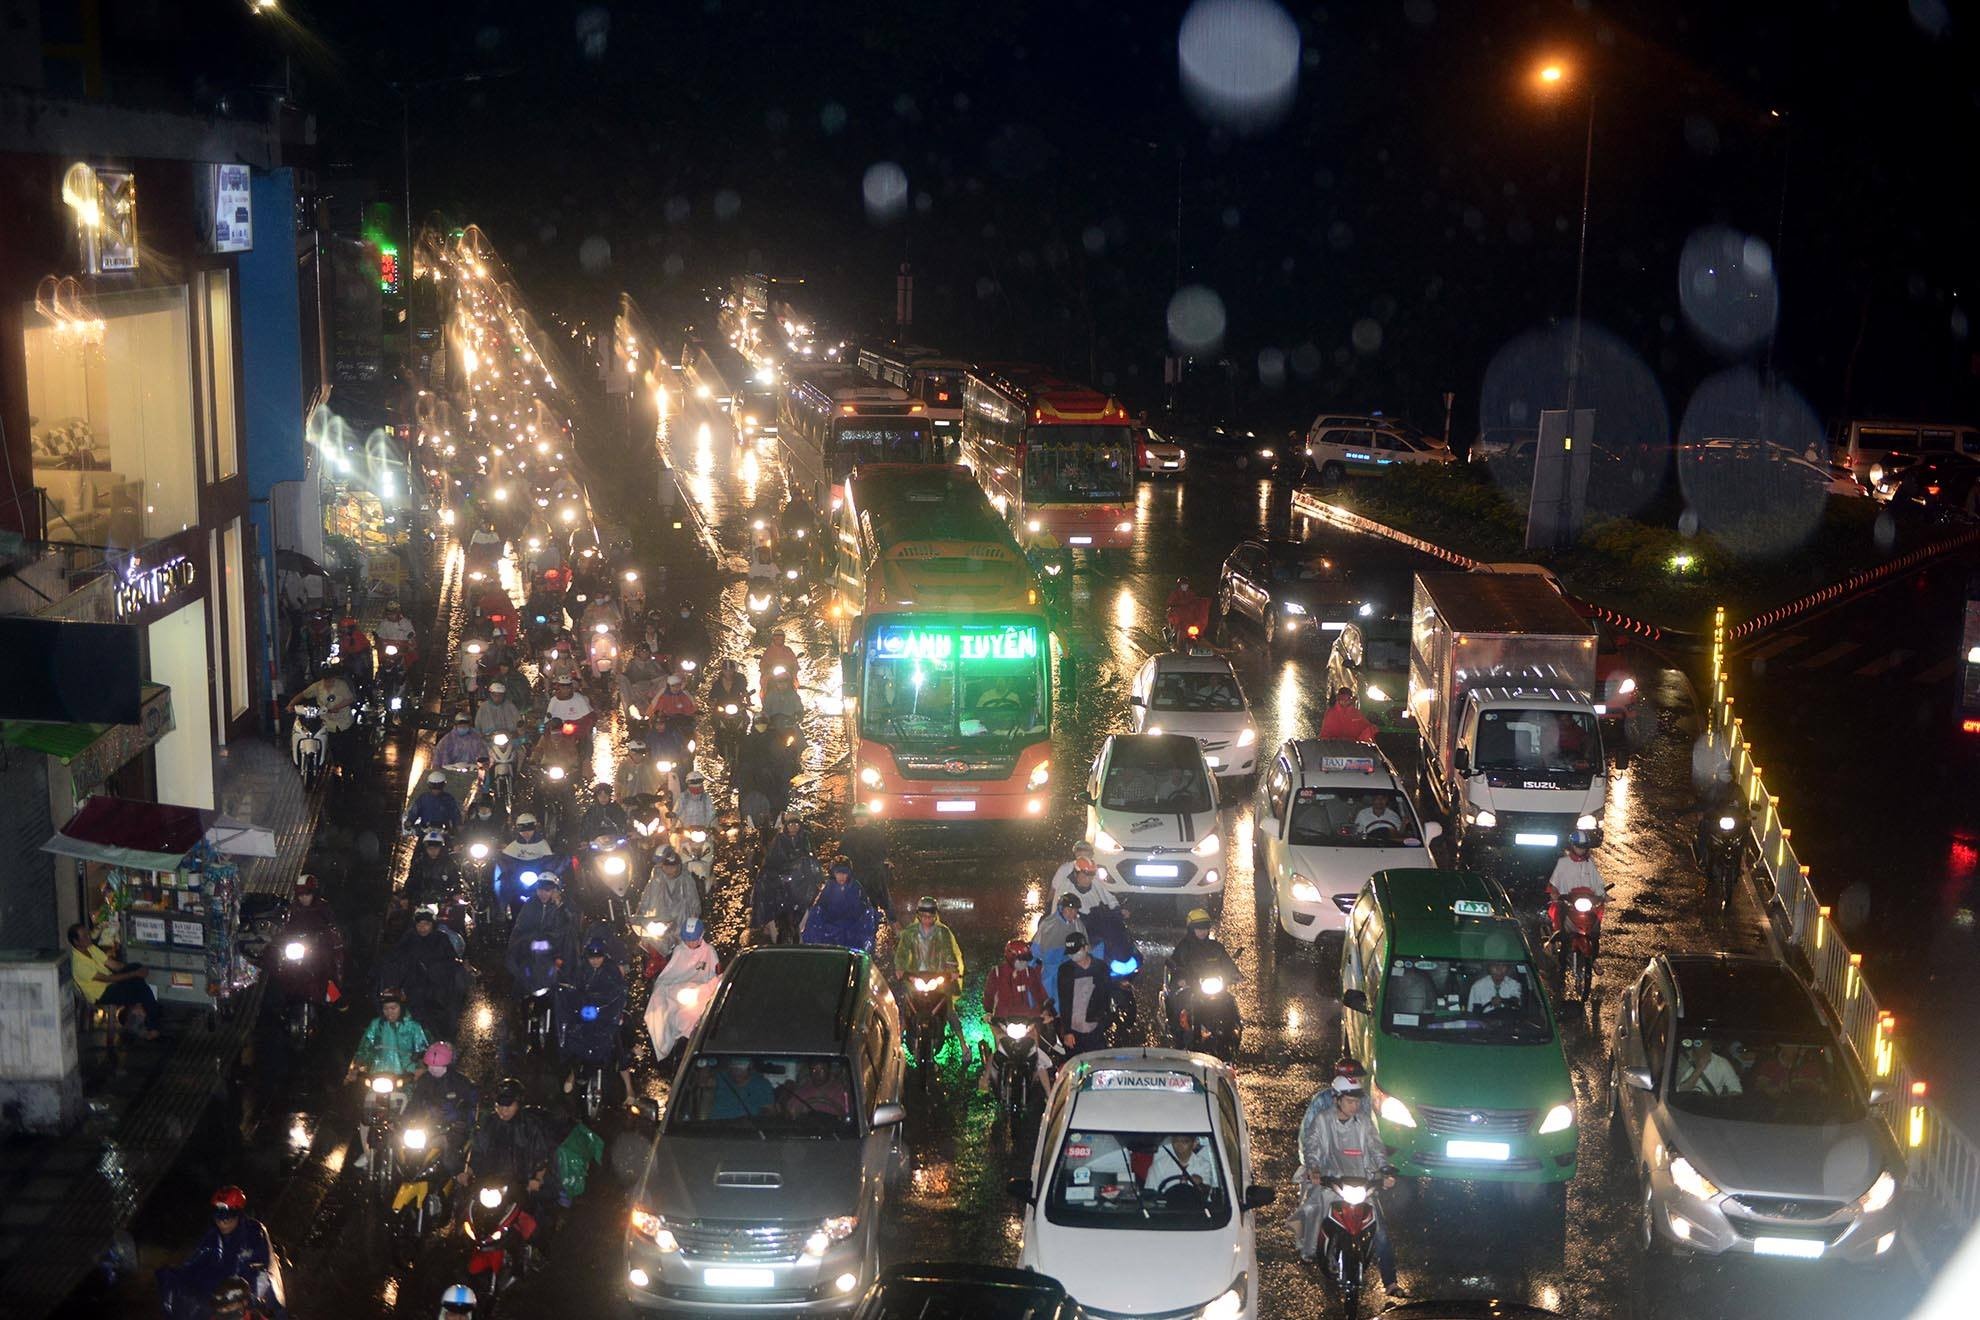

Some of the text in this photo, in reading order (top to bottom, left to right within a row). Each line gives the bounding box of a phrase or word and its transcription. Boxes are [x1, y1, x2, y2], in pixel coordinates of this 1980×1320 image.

[1324, 758, 1344, 766] TAXI
[1523, 781, 1556, 789] ISUZU
[1117, 1076, 1167, 1087] VINASUN
